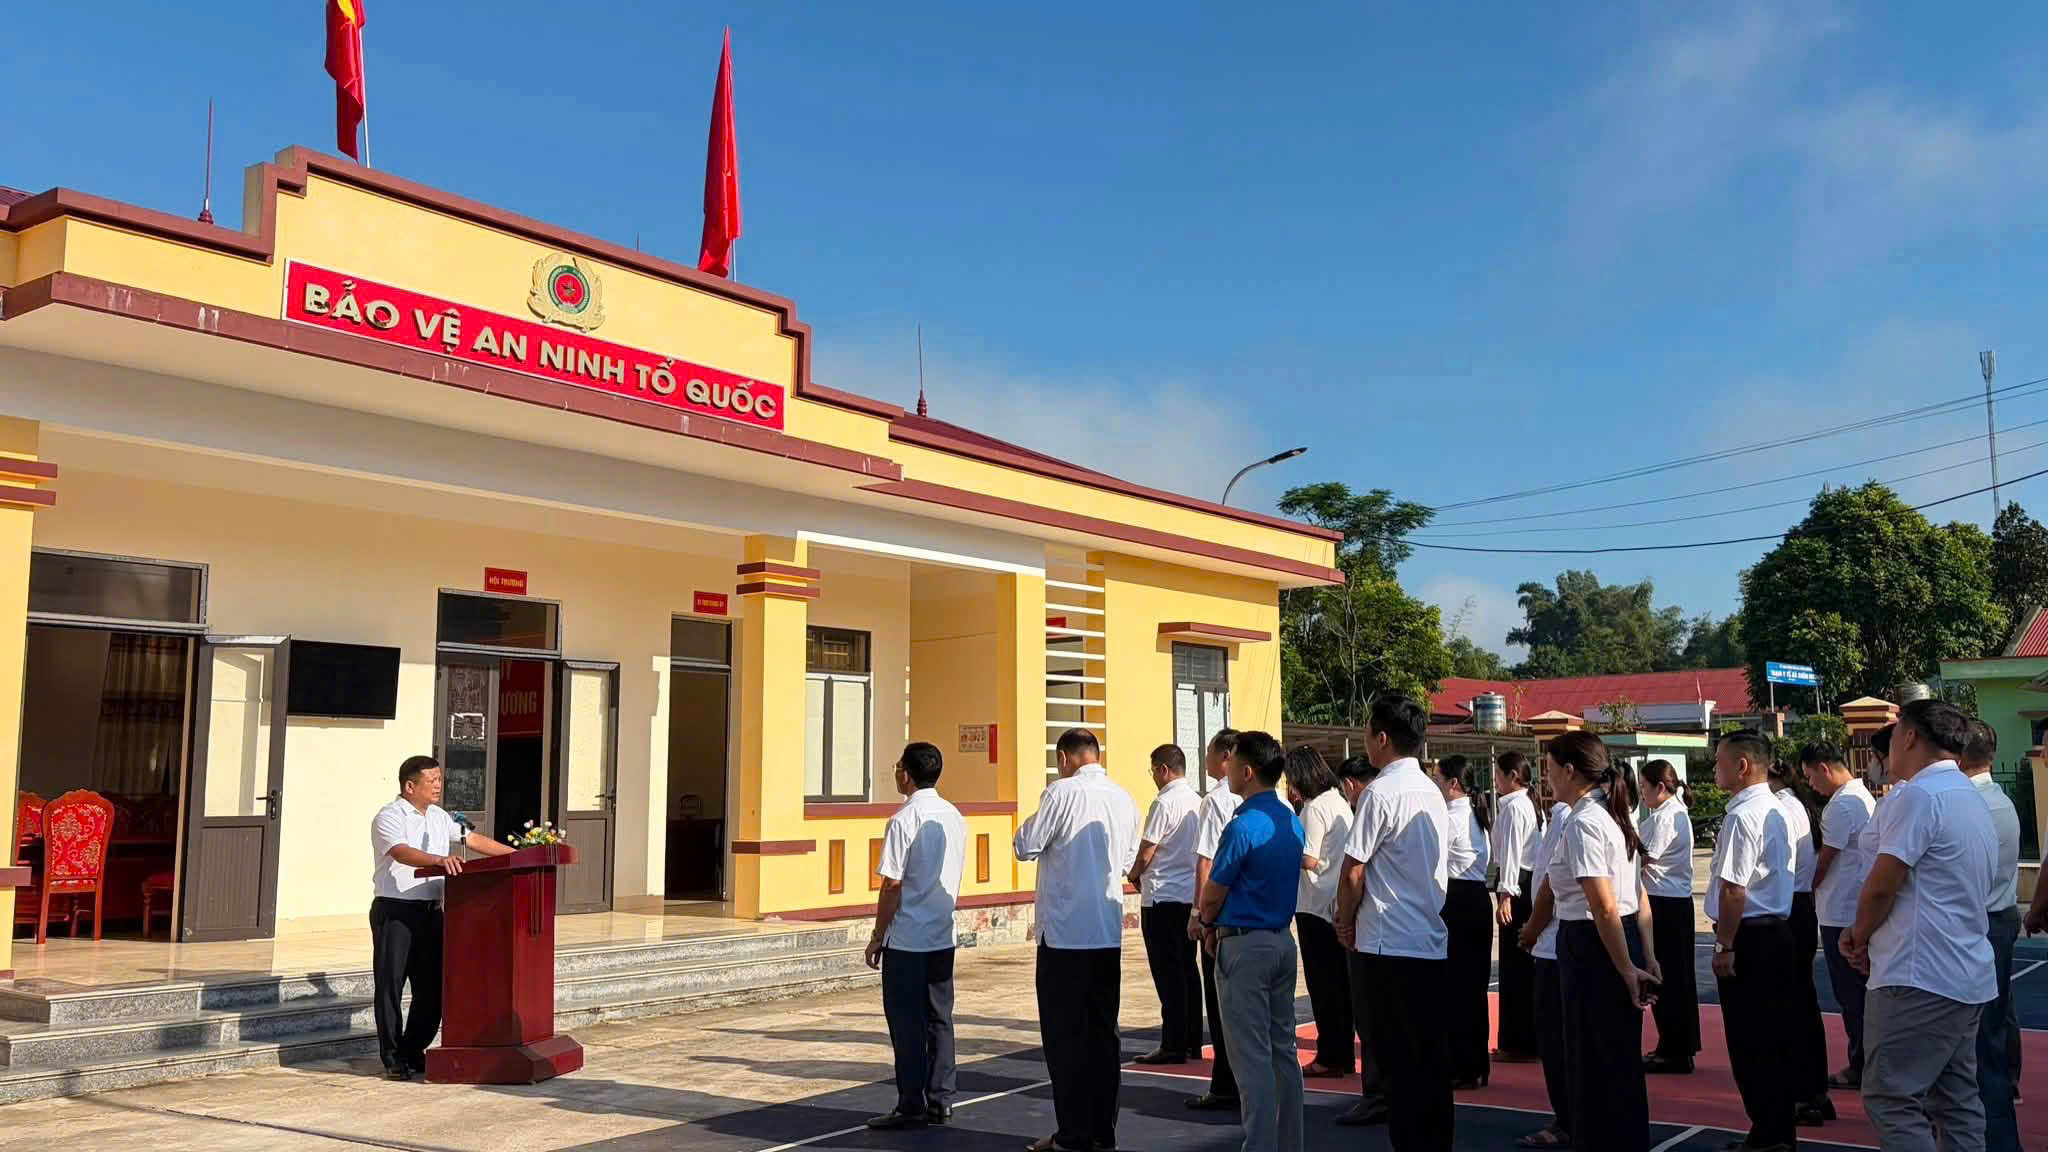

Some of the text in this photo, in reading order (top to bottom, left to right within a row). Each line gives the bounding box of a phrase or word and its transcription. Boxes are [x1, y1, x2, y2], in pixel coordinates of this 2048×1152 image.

[304, 280, 777, 419] BẢO VỆ AN NINH TỔ QUỐC
